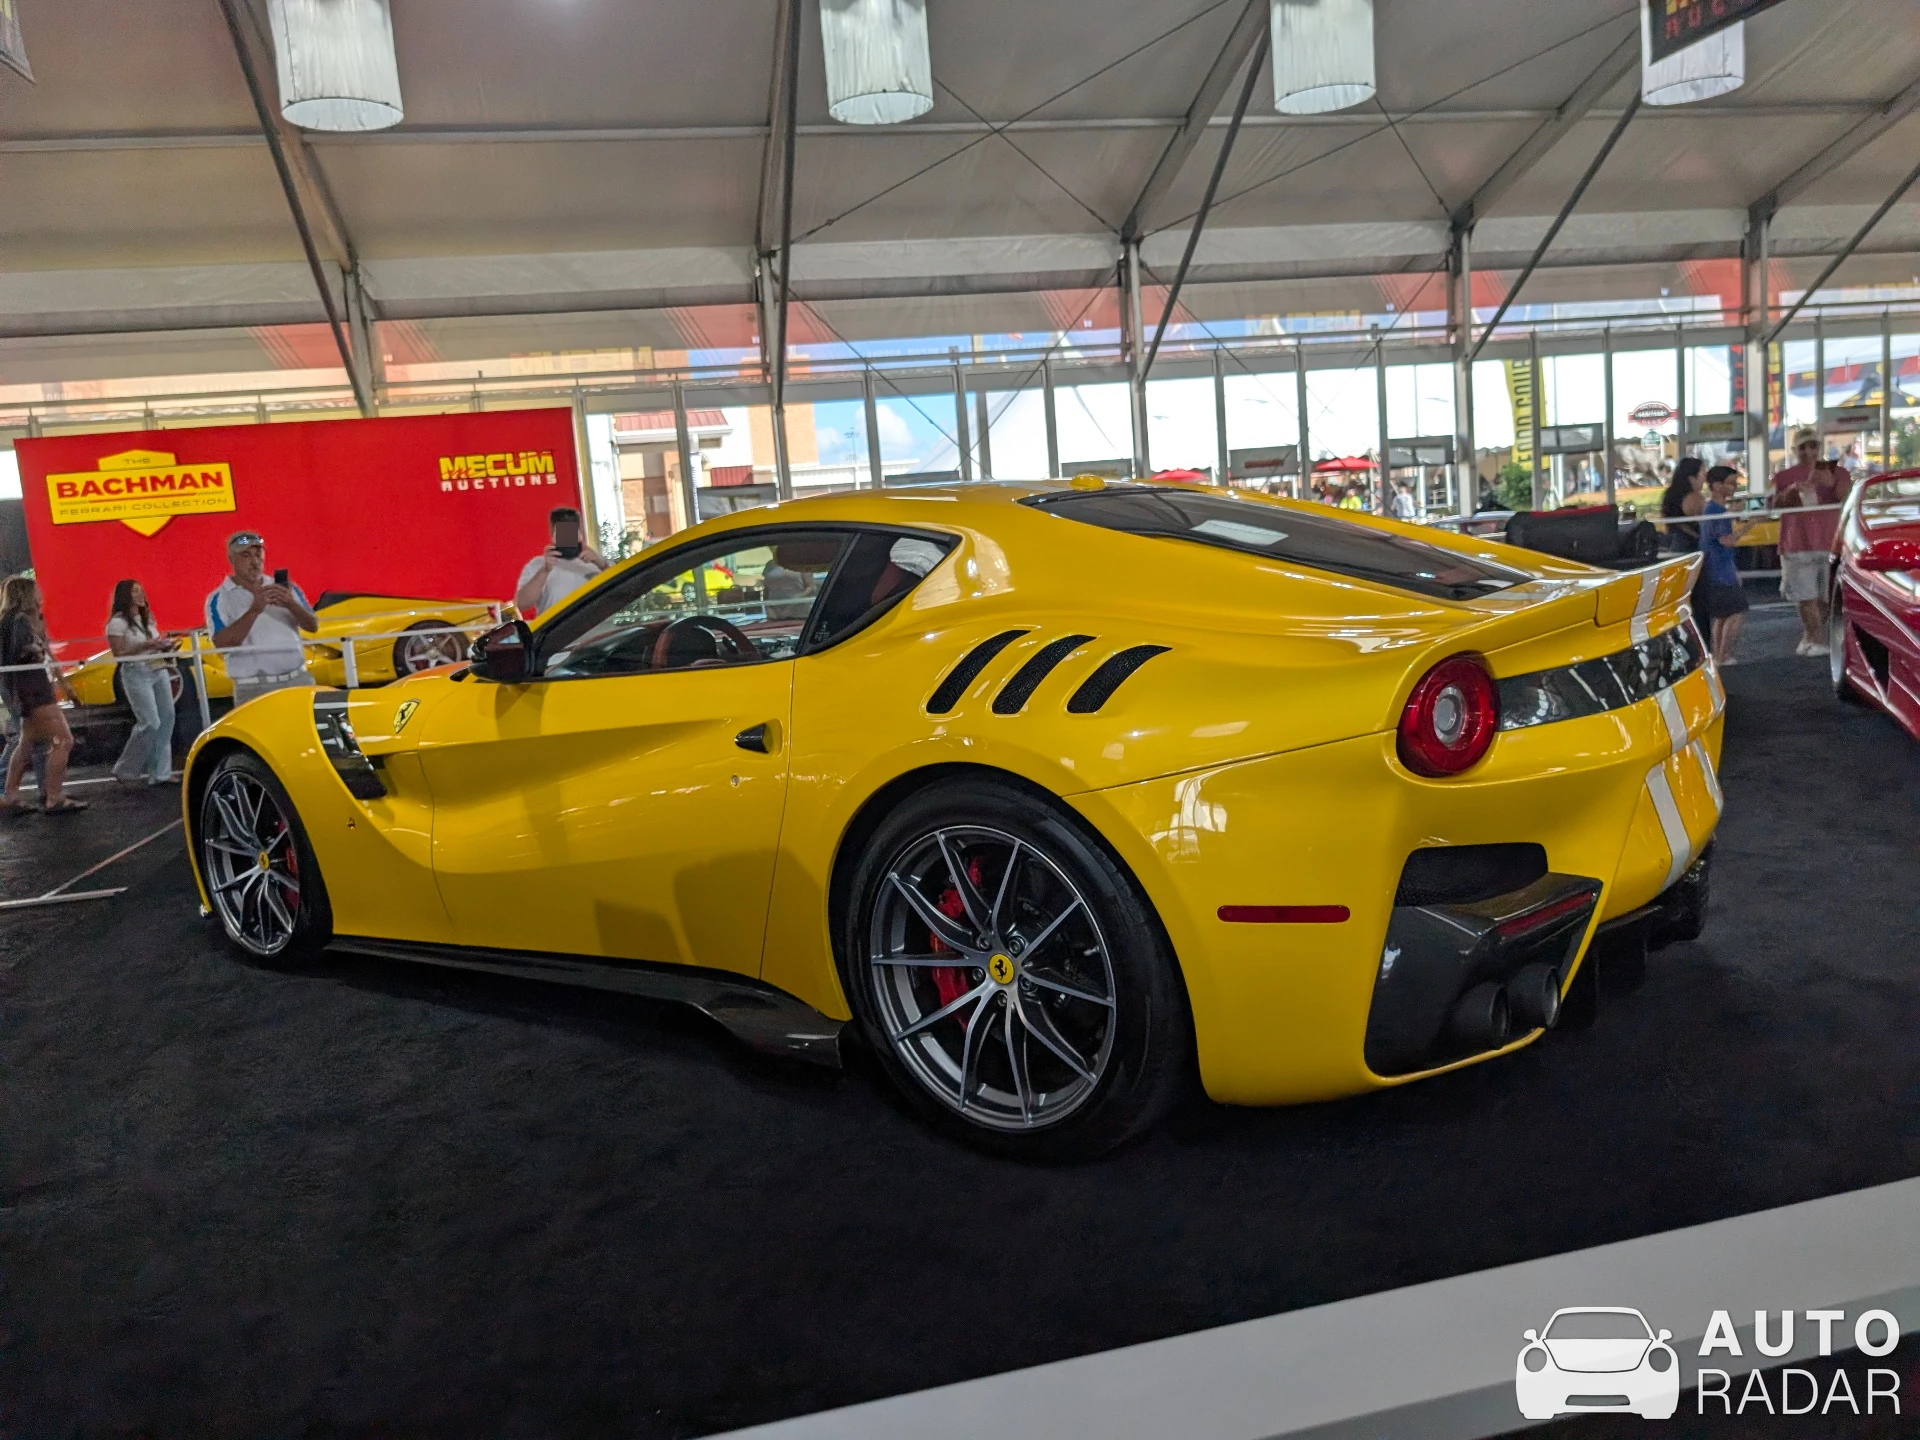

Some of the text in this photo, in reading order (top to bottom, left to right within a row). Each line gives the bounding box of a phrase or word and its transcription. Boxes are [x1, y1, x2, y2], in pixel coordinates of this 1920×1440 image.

[1512, 359, 1532, 408] COUR
[439, 451, 555, 480] MECUM
[56, 471, 224, 499] BACHMAN
[441, 473, 557, 492] AUCTIONS
[60, 497, 228, 516] FERRARI COLLECTION
